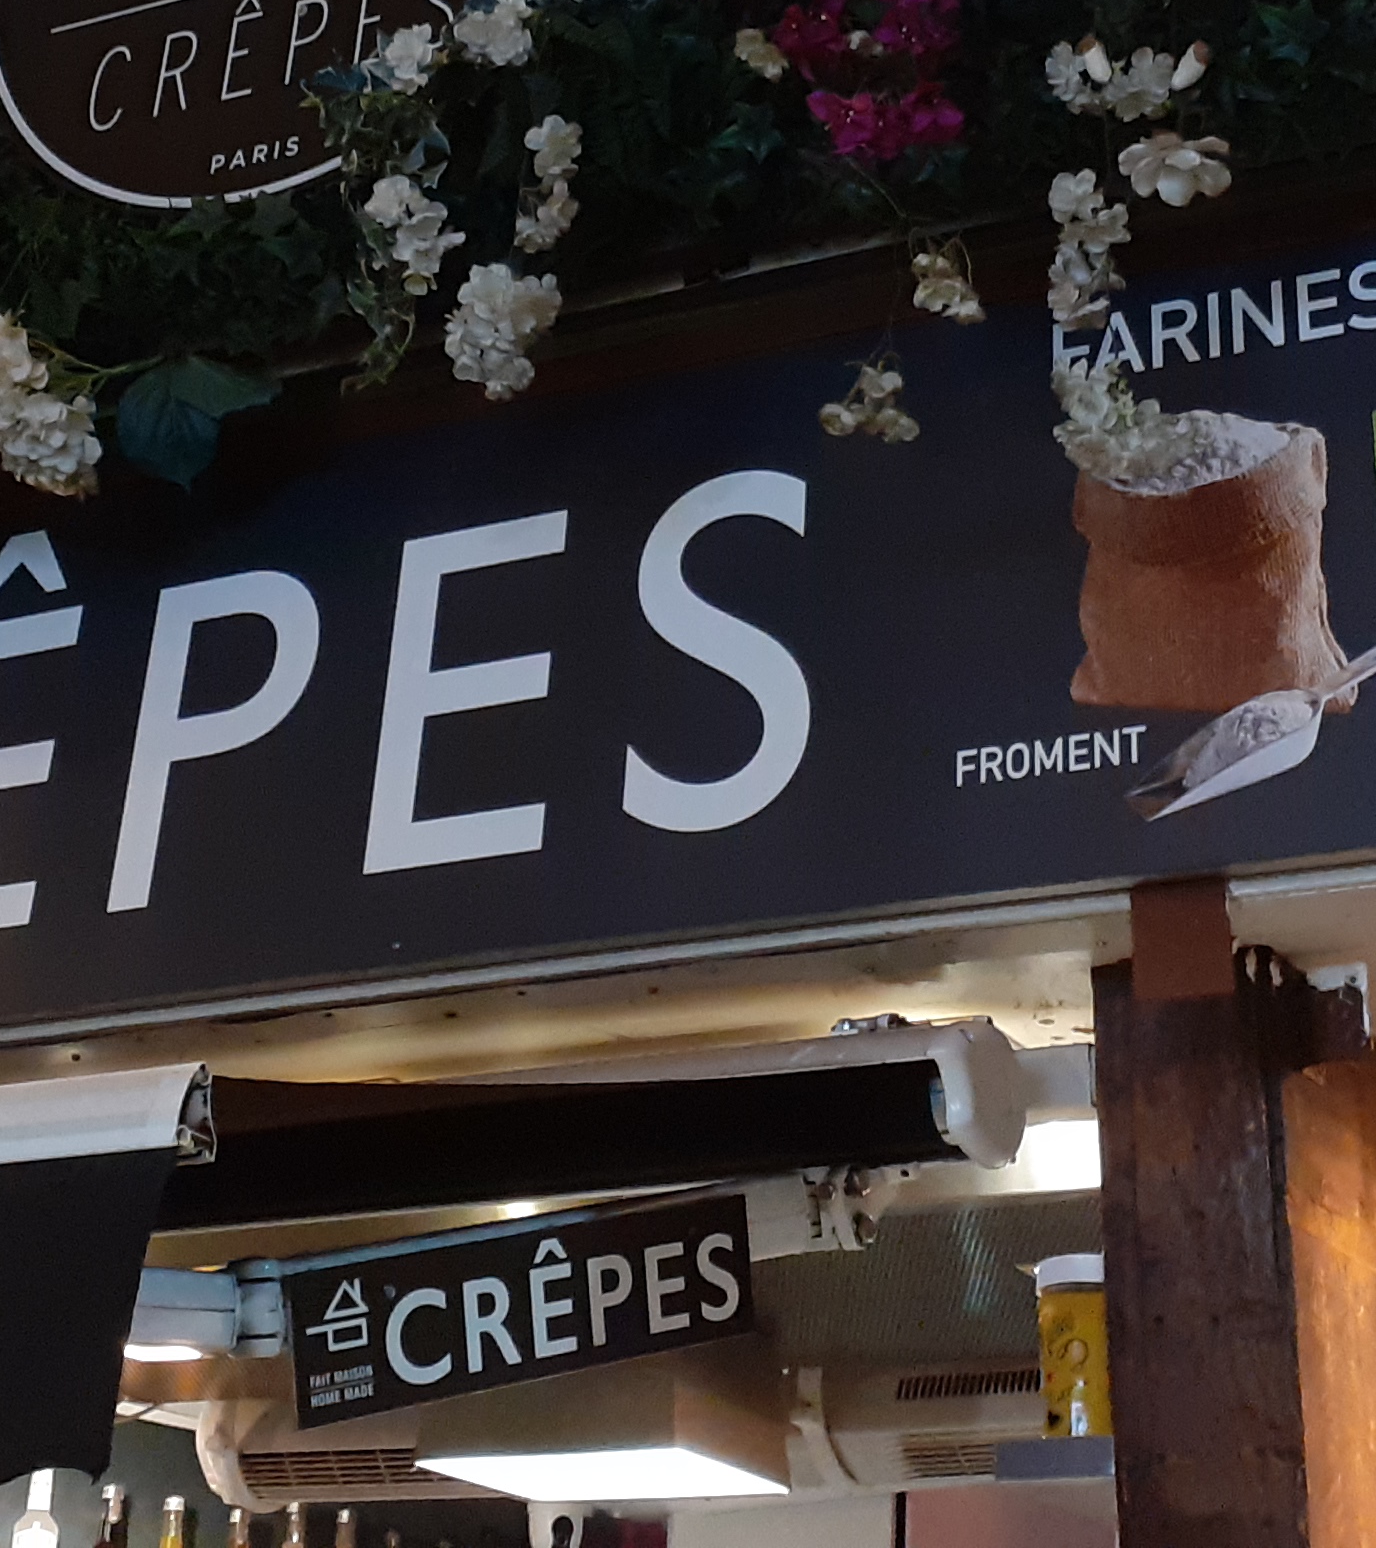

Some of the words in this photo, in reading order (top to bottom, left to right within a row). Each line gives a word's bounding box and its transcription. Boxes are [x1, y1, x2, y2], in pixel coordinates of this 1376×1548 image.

[210, 136, 300, 175] PARIS
[954, 725, 1147, 787] FROMENT
[385, 1232, 741, 1386] CRÊPES
[309, 1372, 331, 1389] FAIT
[310, 1389, 342, 1409] HOME
[344, 1382, 375, 1401] MADE
